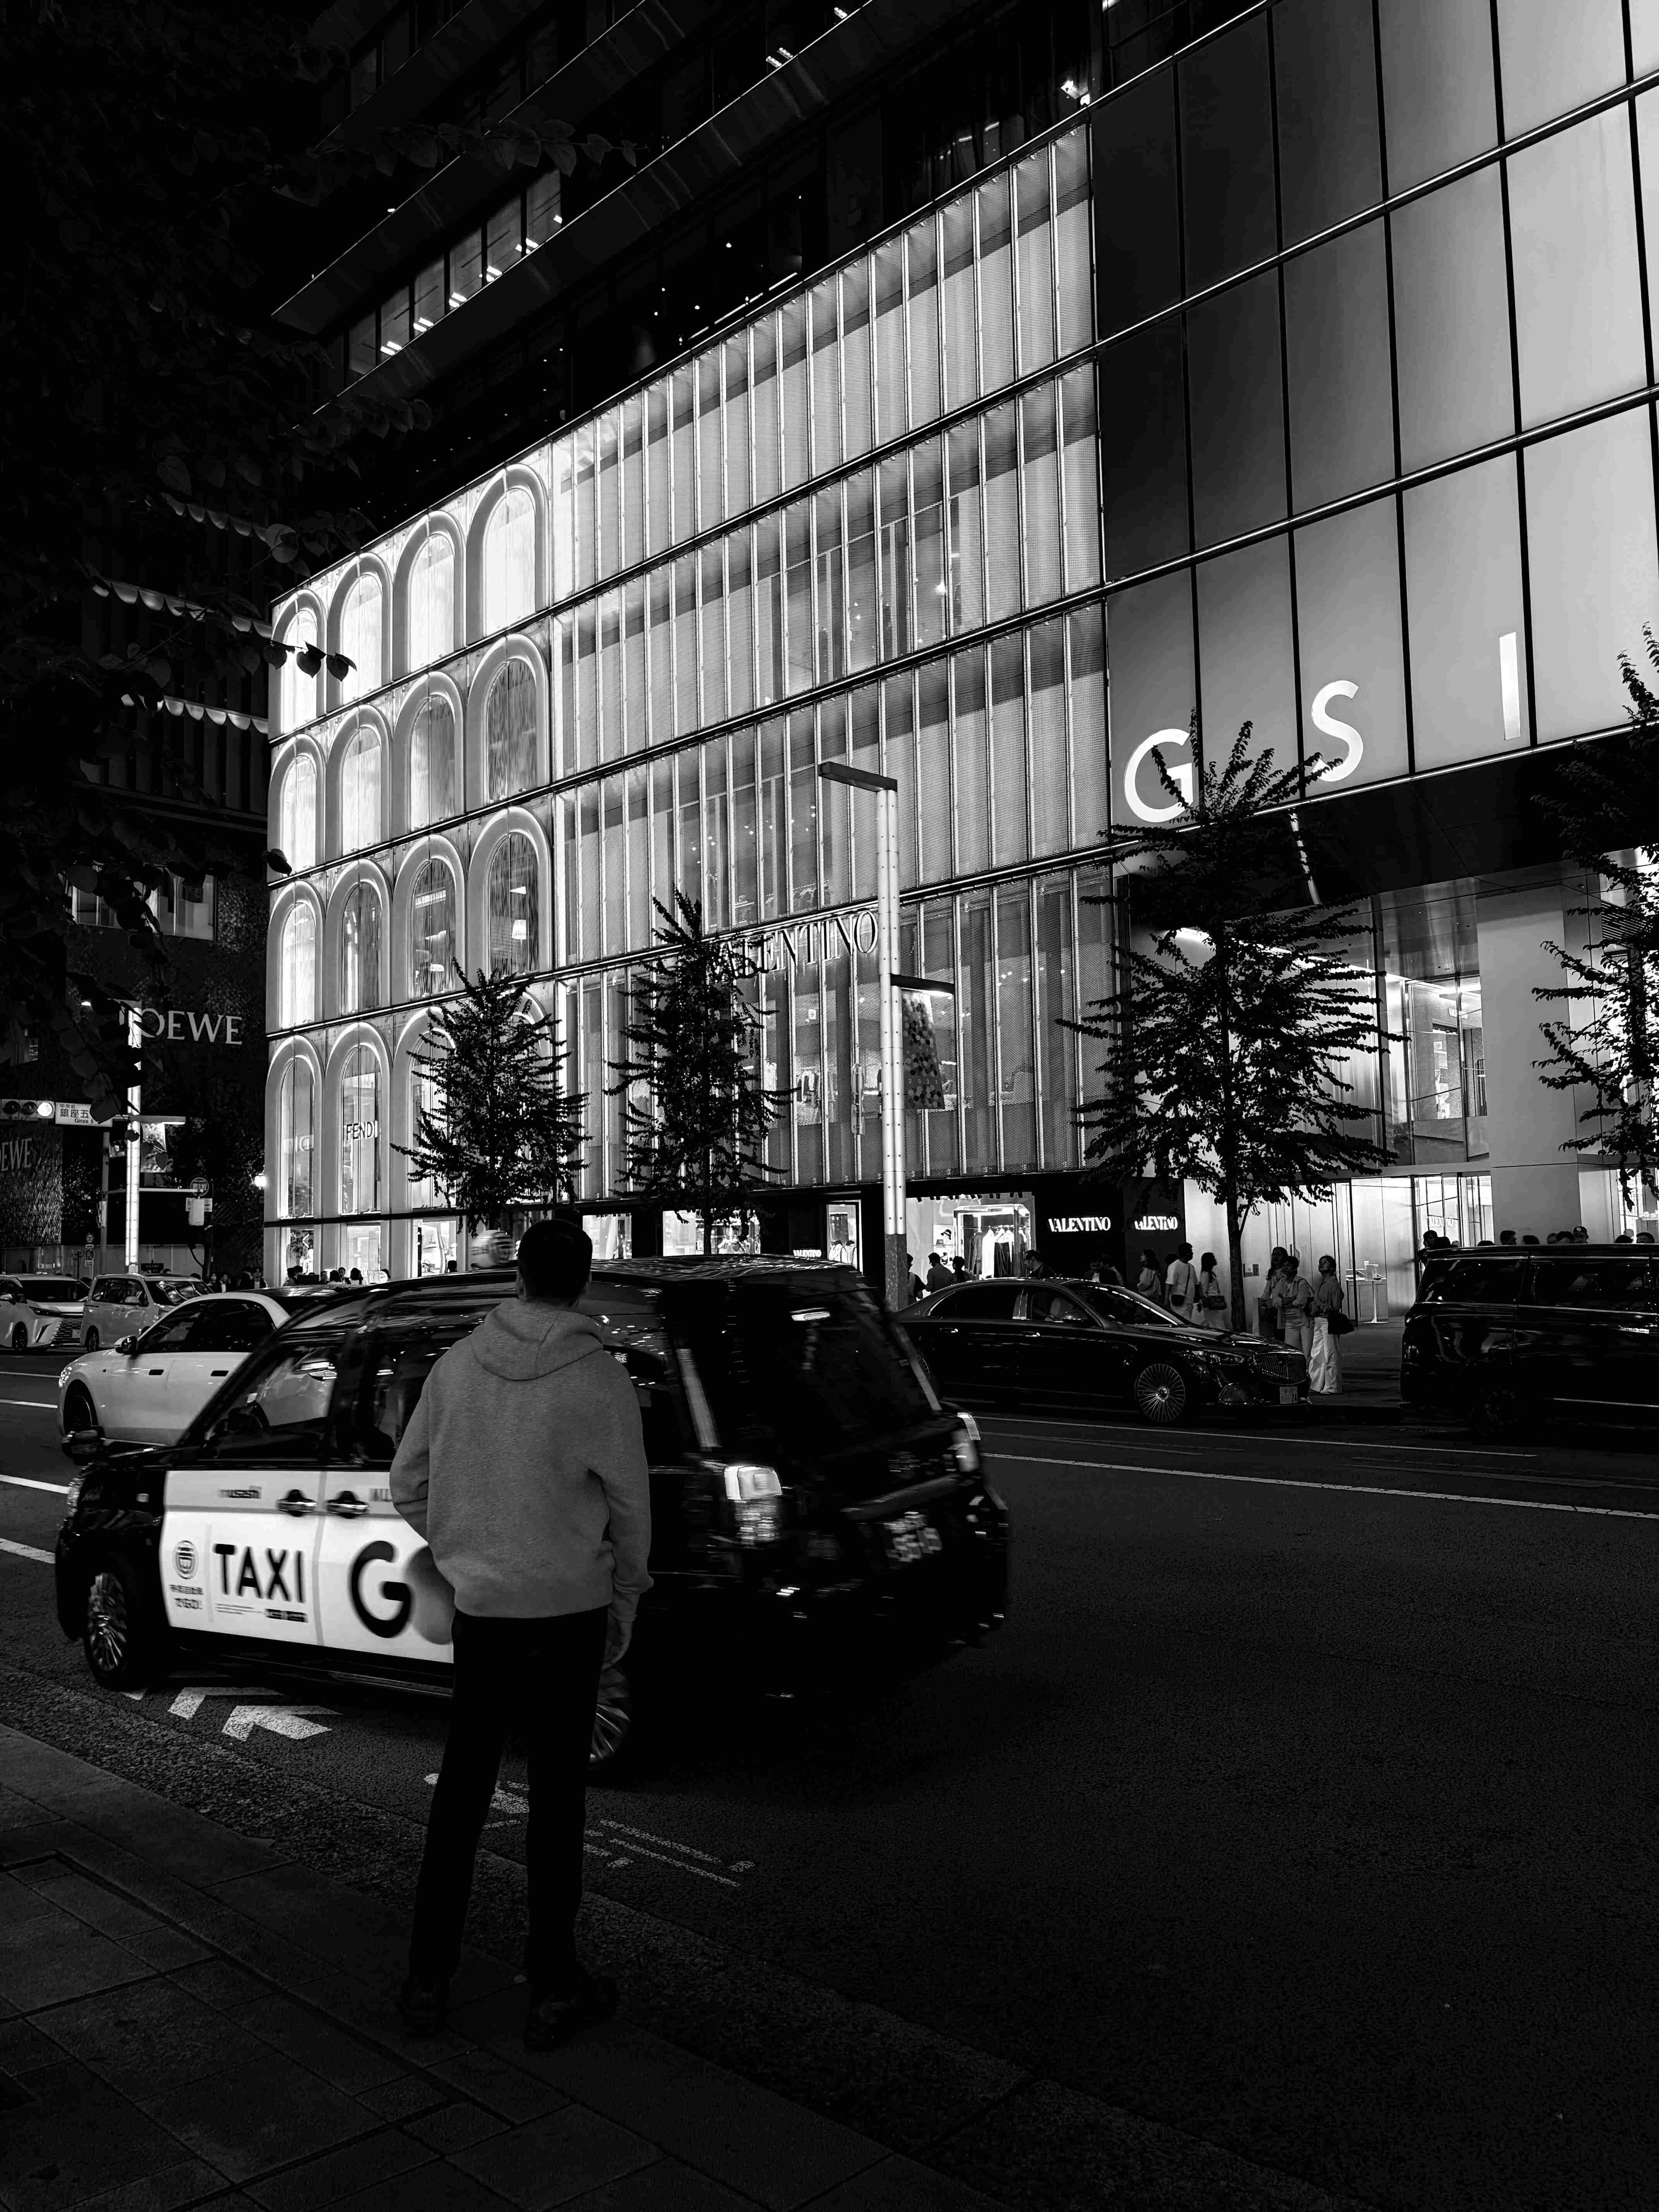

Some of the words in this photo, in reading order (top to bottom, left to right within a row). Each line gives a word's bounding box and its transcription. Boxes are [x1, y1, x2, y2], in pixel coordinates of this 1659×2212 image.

[712, 911, 878, 977] ALENTINO
[119, 1006, 243, 1045] OEWE
[344, 1120, 378, 1140] FENDI
[0, 1138, 32, 1171] EWE
[1048, 1217, 1111, 1232] VALENTINO
[212, 1543, 308, 1604] TAXI
